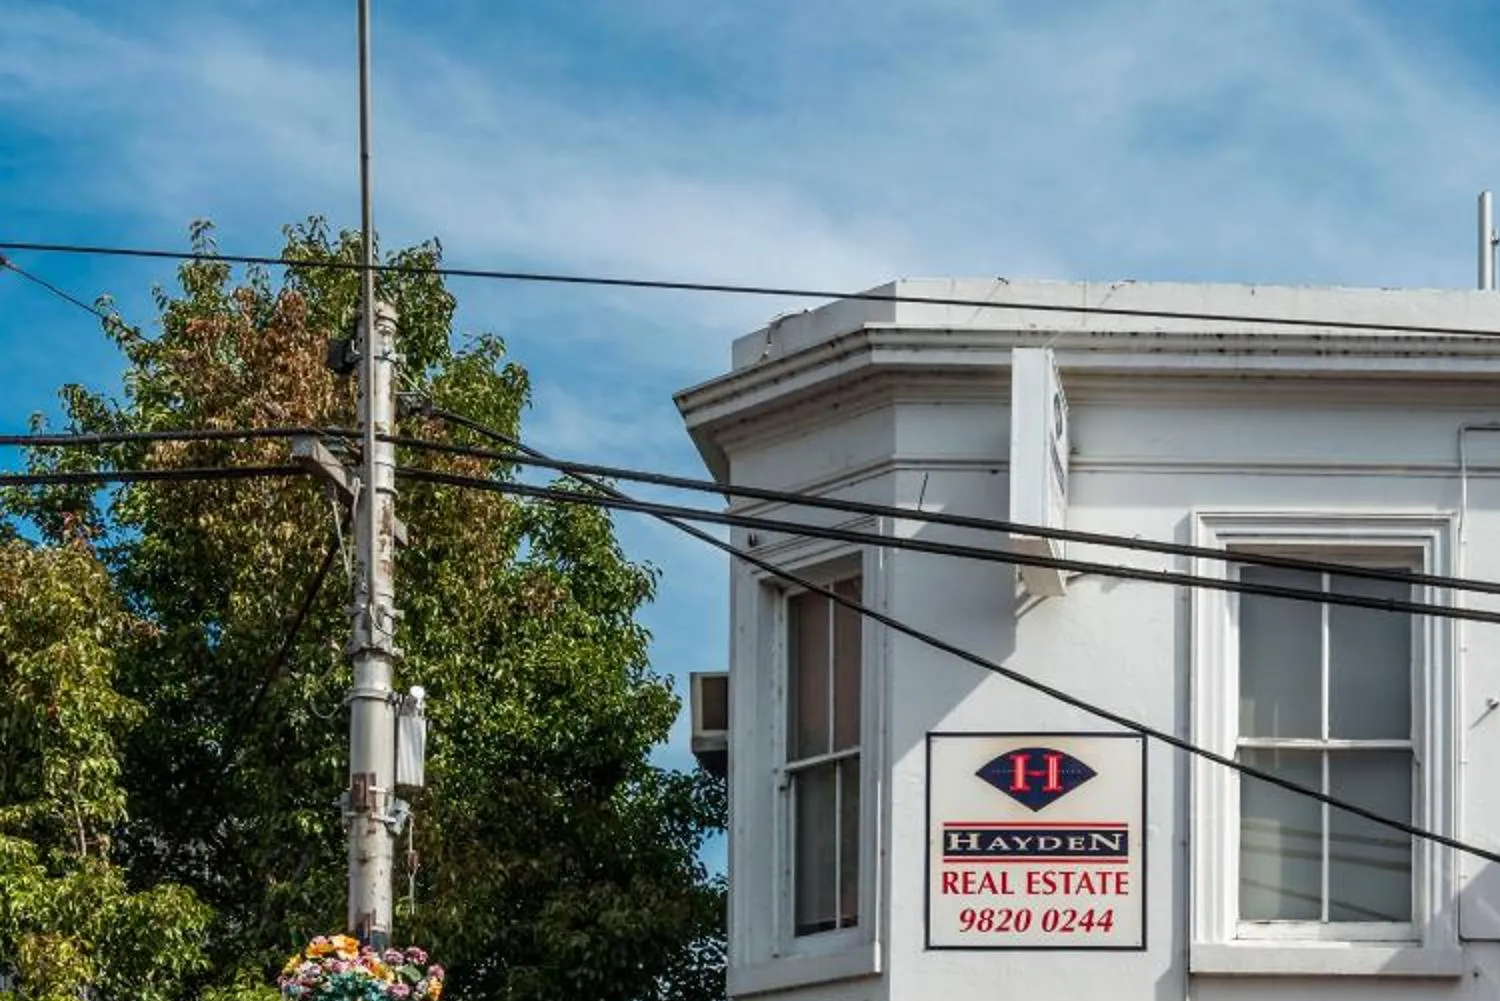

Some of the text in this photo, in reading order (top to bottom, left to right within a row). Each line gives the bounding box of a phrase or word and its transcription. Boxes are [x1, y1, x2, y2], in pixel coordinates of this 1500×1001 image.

[1009, 753, 1063, 793] H
[947, 832, 1124, 851] HAYDEN
[942, 871, 1129, 895] REAL ESTATE
[959, 908, 1114, 933] 9820 0244
